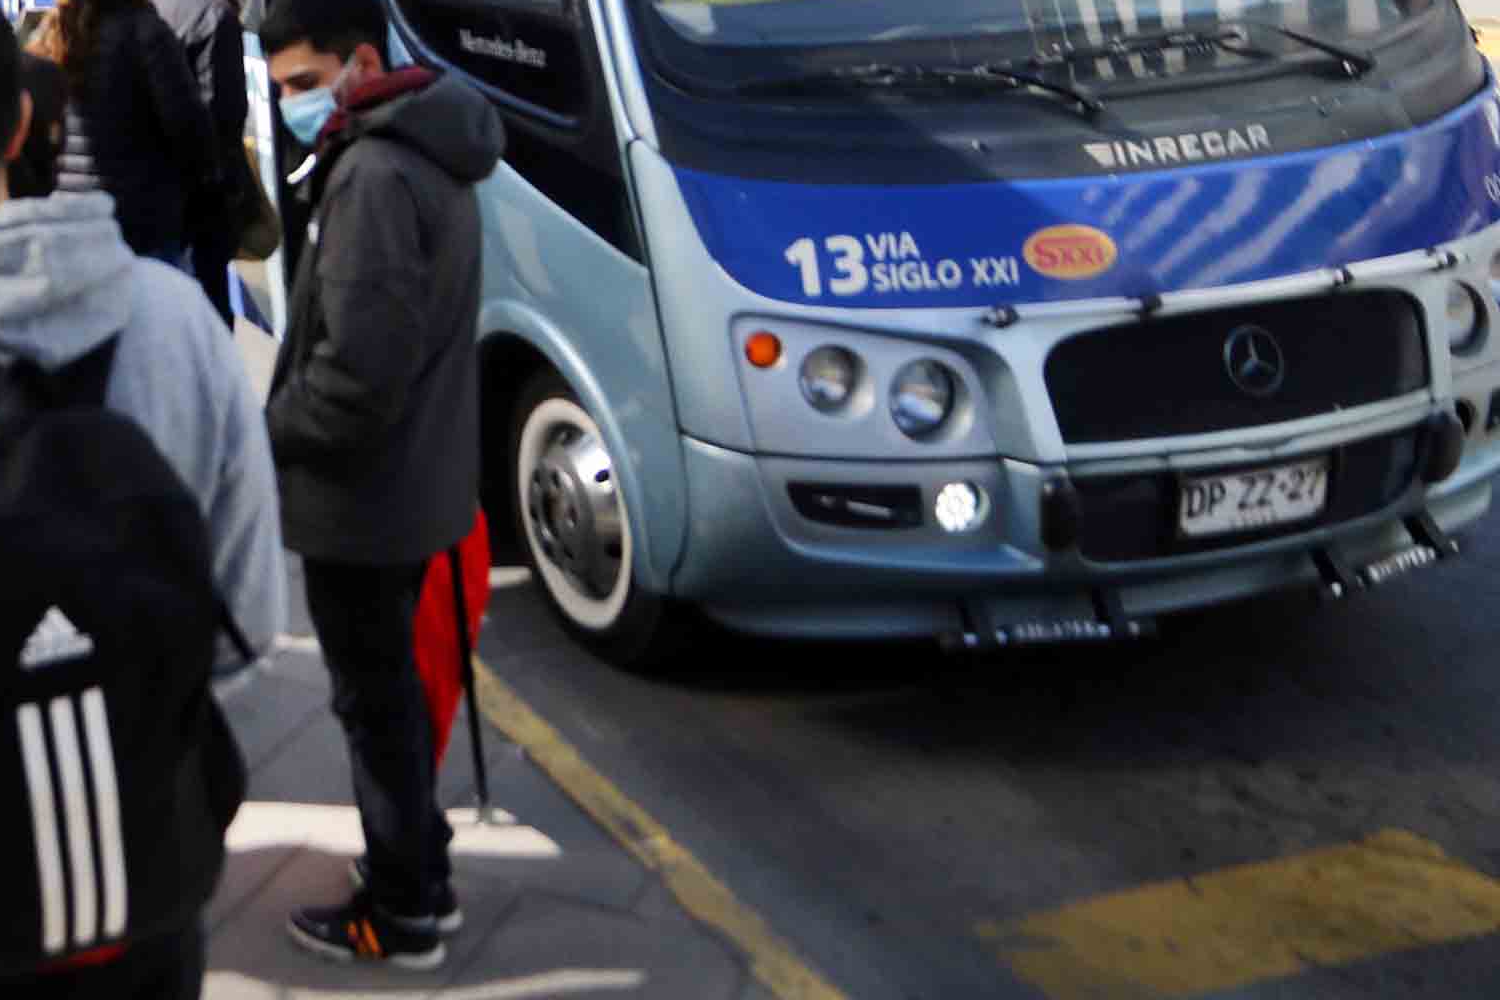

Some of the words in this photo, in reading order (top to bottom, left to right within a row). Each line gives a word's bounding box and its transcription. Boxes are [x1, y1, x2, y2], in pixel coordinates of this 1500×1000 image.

[784, 234, 869, 297] 13
[866, 231, 920, 259] VIA
[870, 260, 963, 291] SIGLO
[970, 256, 1020, 286] XXI
